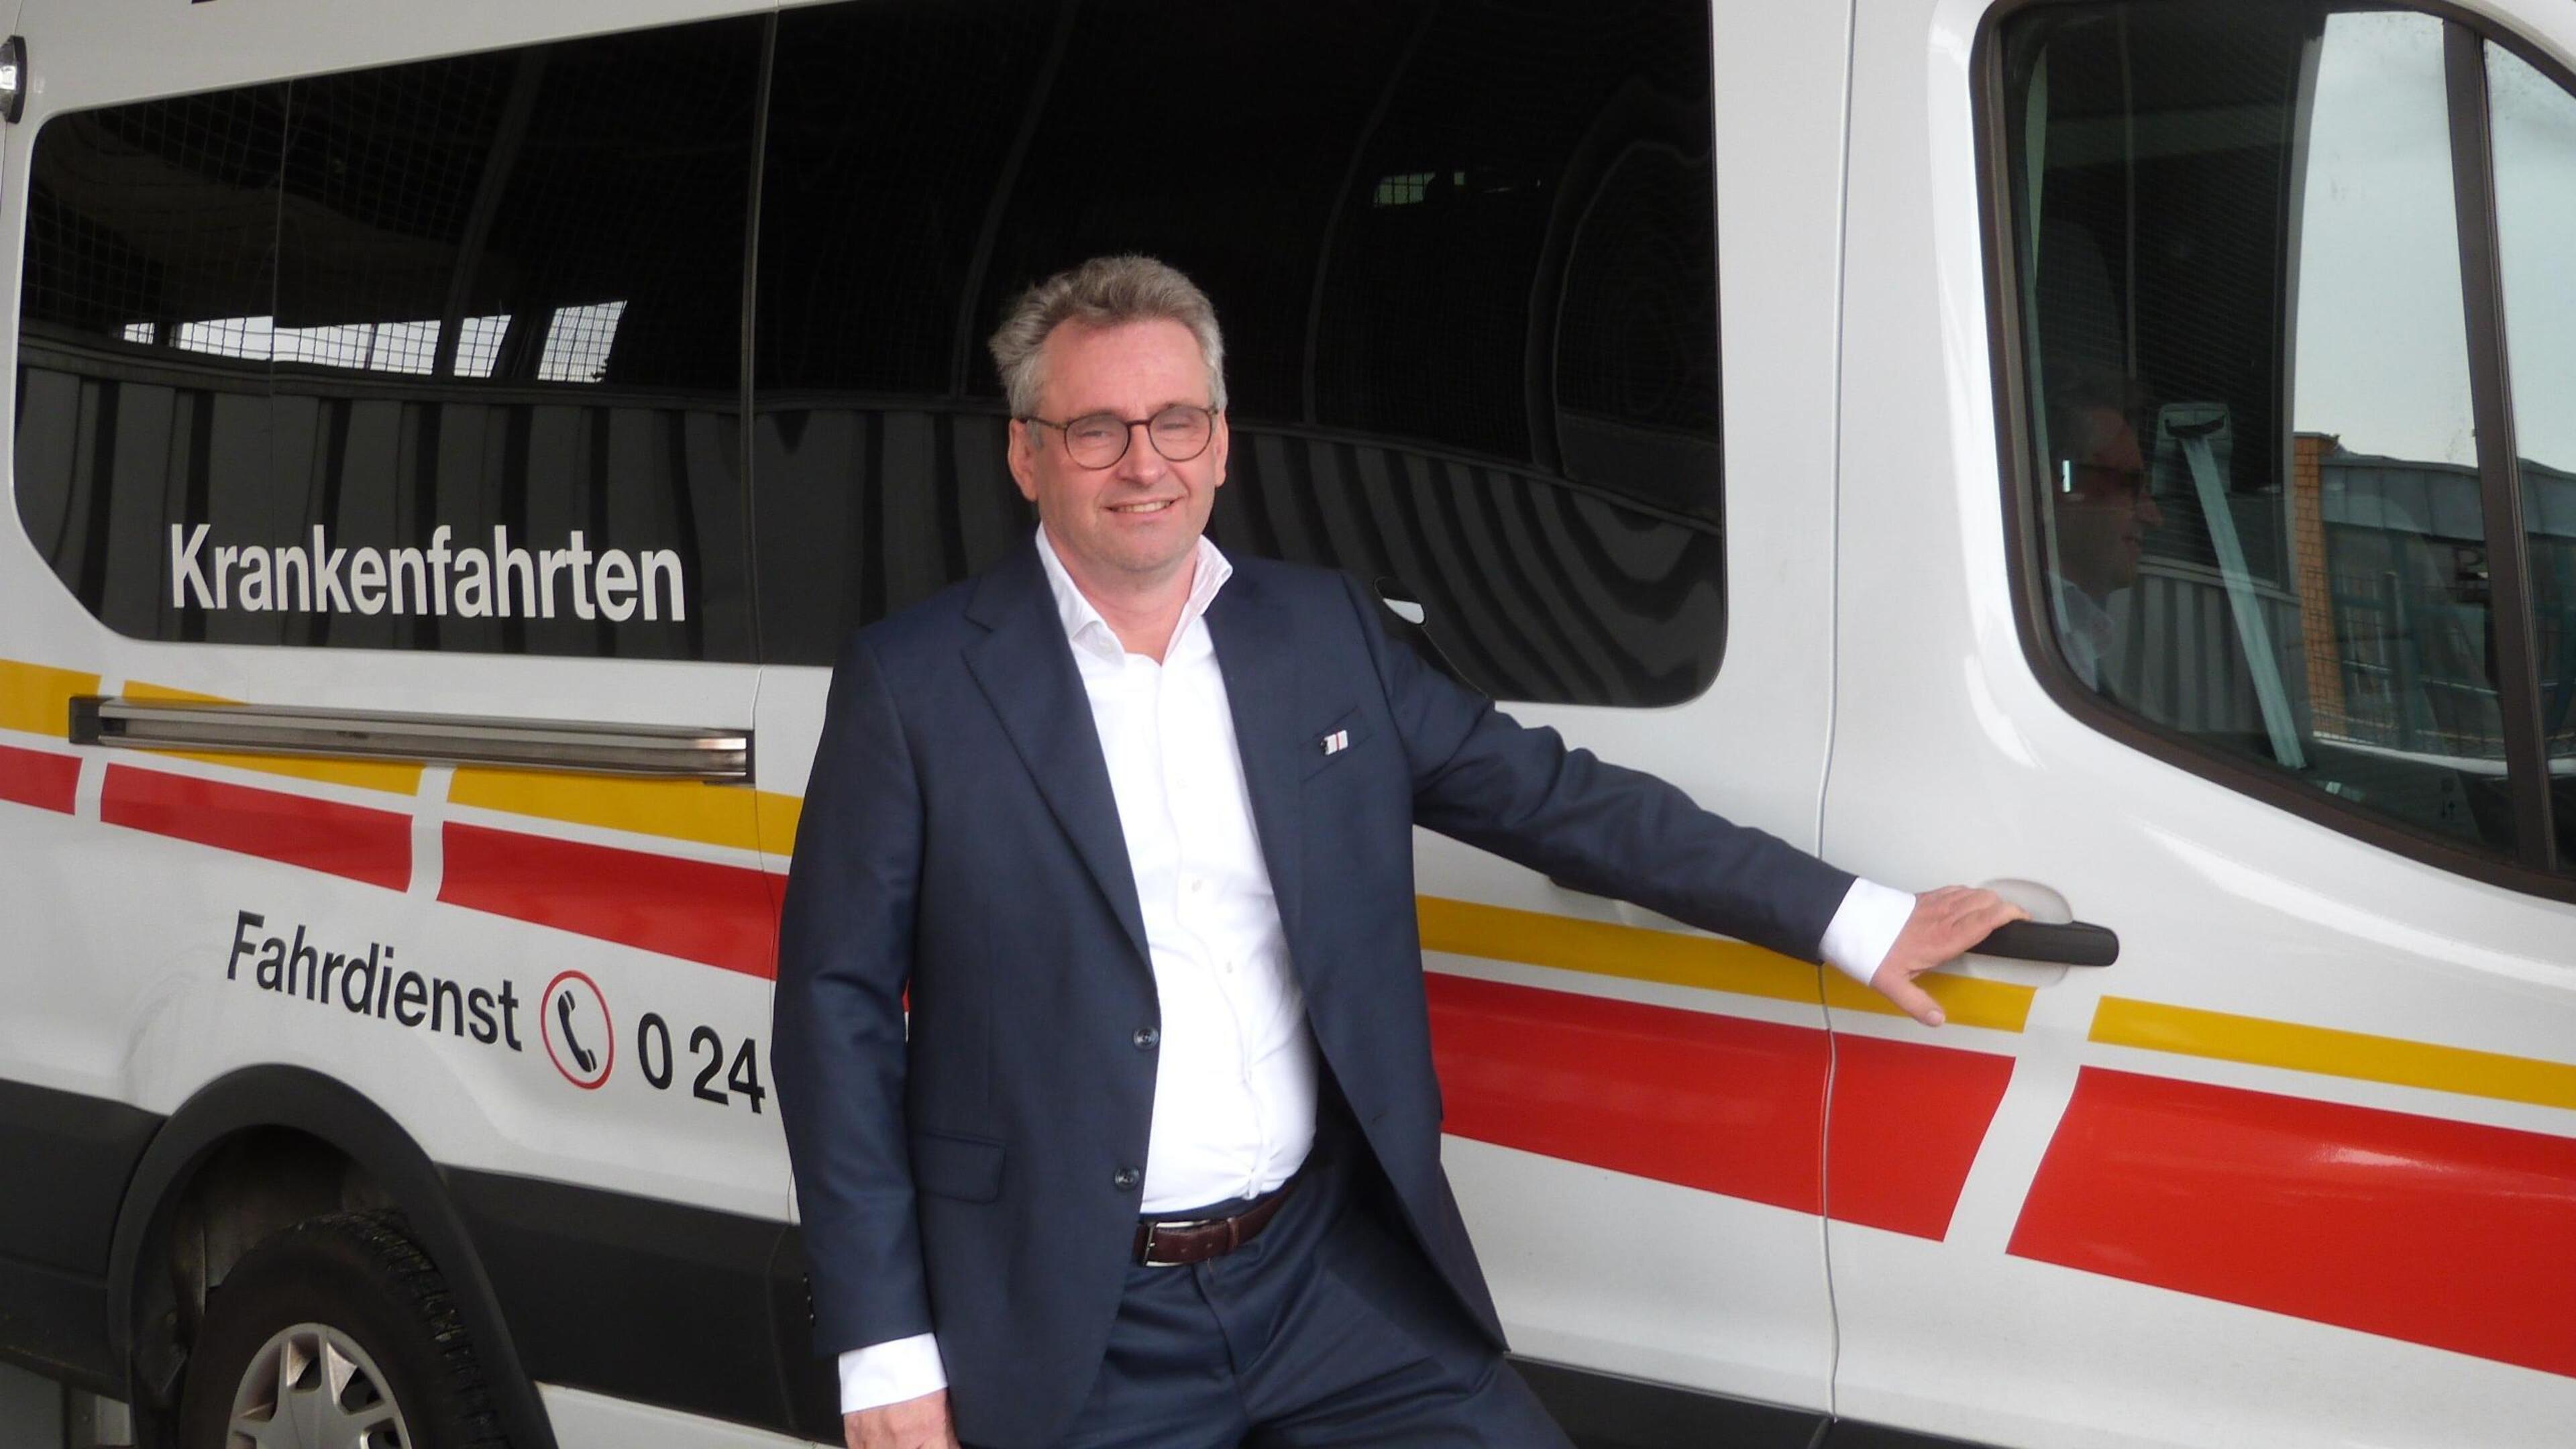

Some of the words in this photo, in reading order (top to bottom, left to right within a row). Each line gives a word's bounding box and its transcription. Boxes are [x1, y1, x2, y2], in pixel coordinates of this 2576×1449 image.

[171, 523, 686, 622] Krankenfahrten
[227, 910, 523, 1052] Fahrdienst
[688, 1024, 766, 1115] 24
